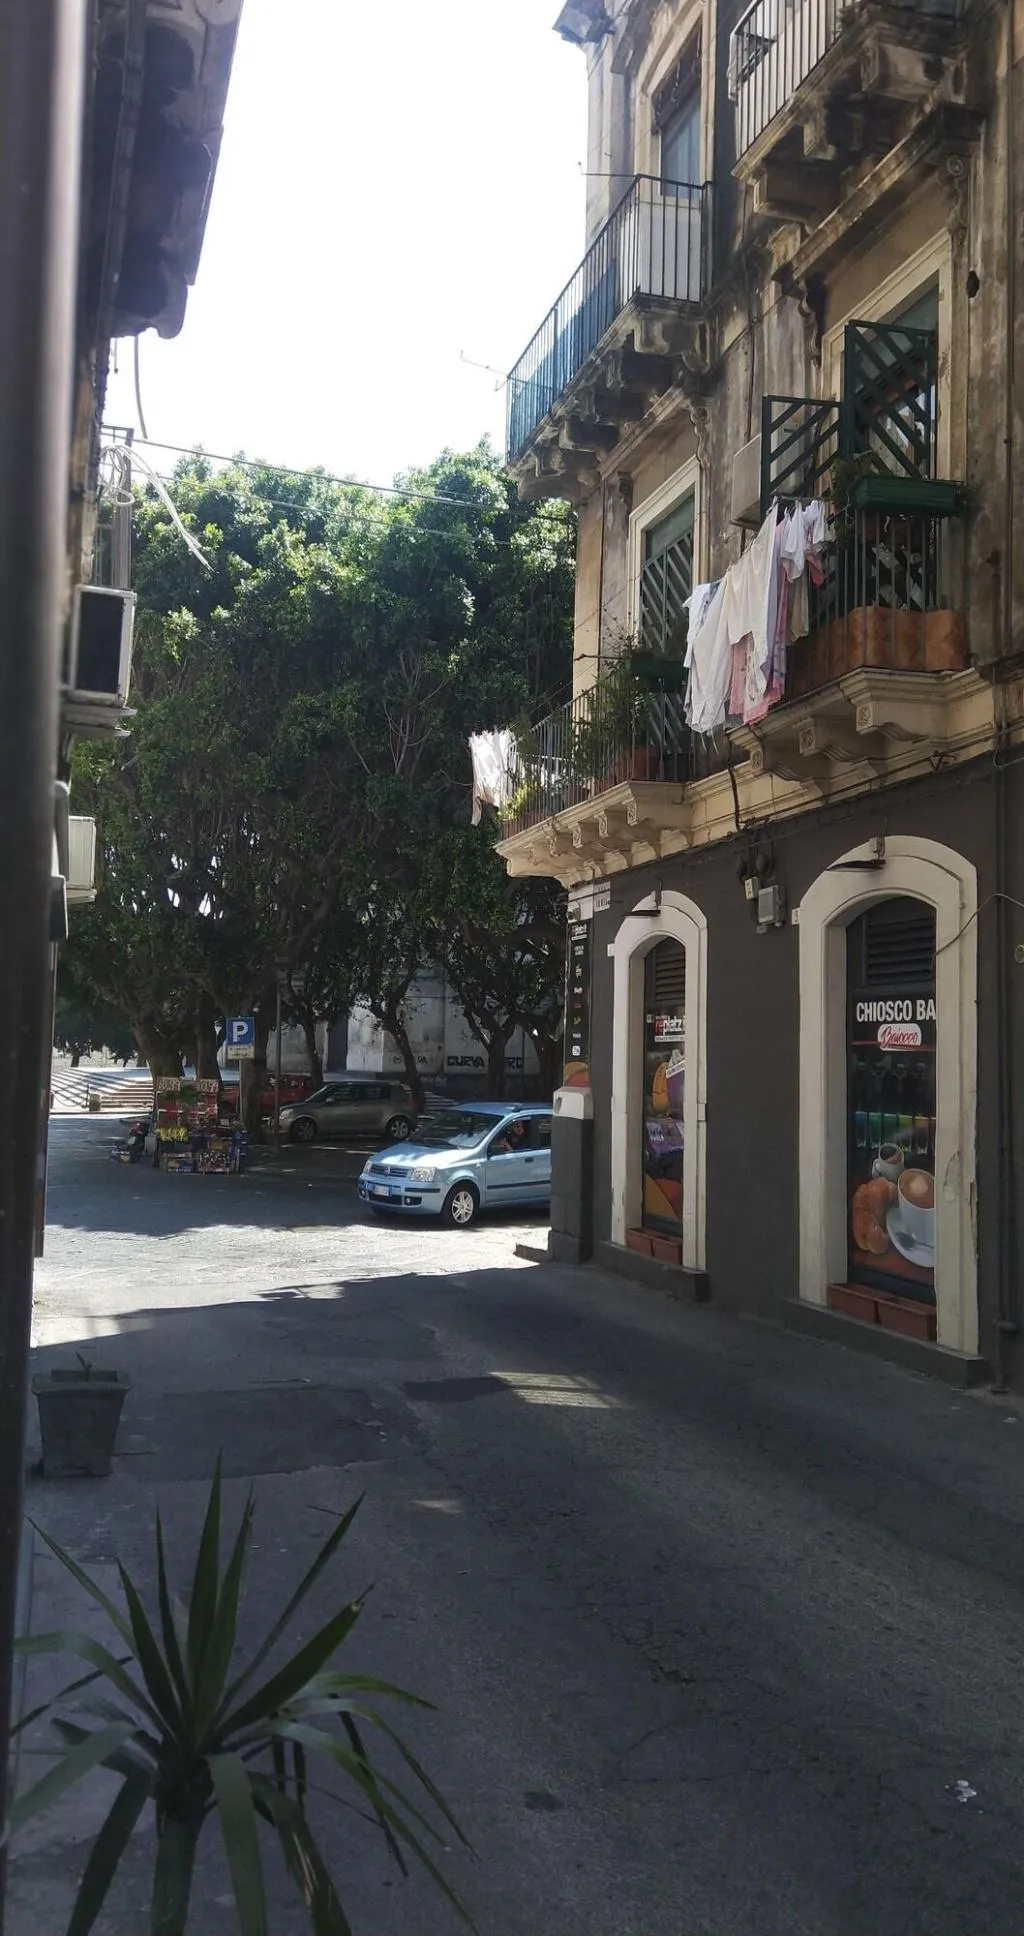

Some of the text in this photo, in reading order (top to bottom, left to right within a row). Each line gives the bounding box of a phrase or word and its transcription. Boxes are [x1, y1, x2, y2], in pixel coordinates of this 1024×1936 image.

[857, 1000, 913, 1022] CHIOSCO
[232, 1021, 249, 1042] P
[447, 1056, 486, 1068] CURVA
